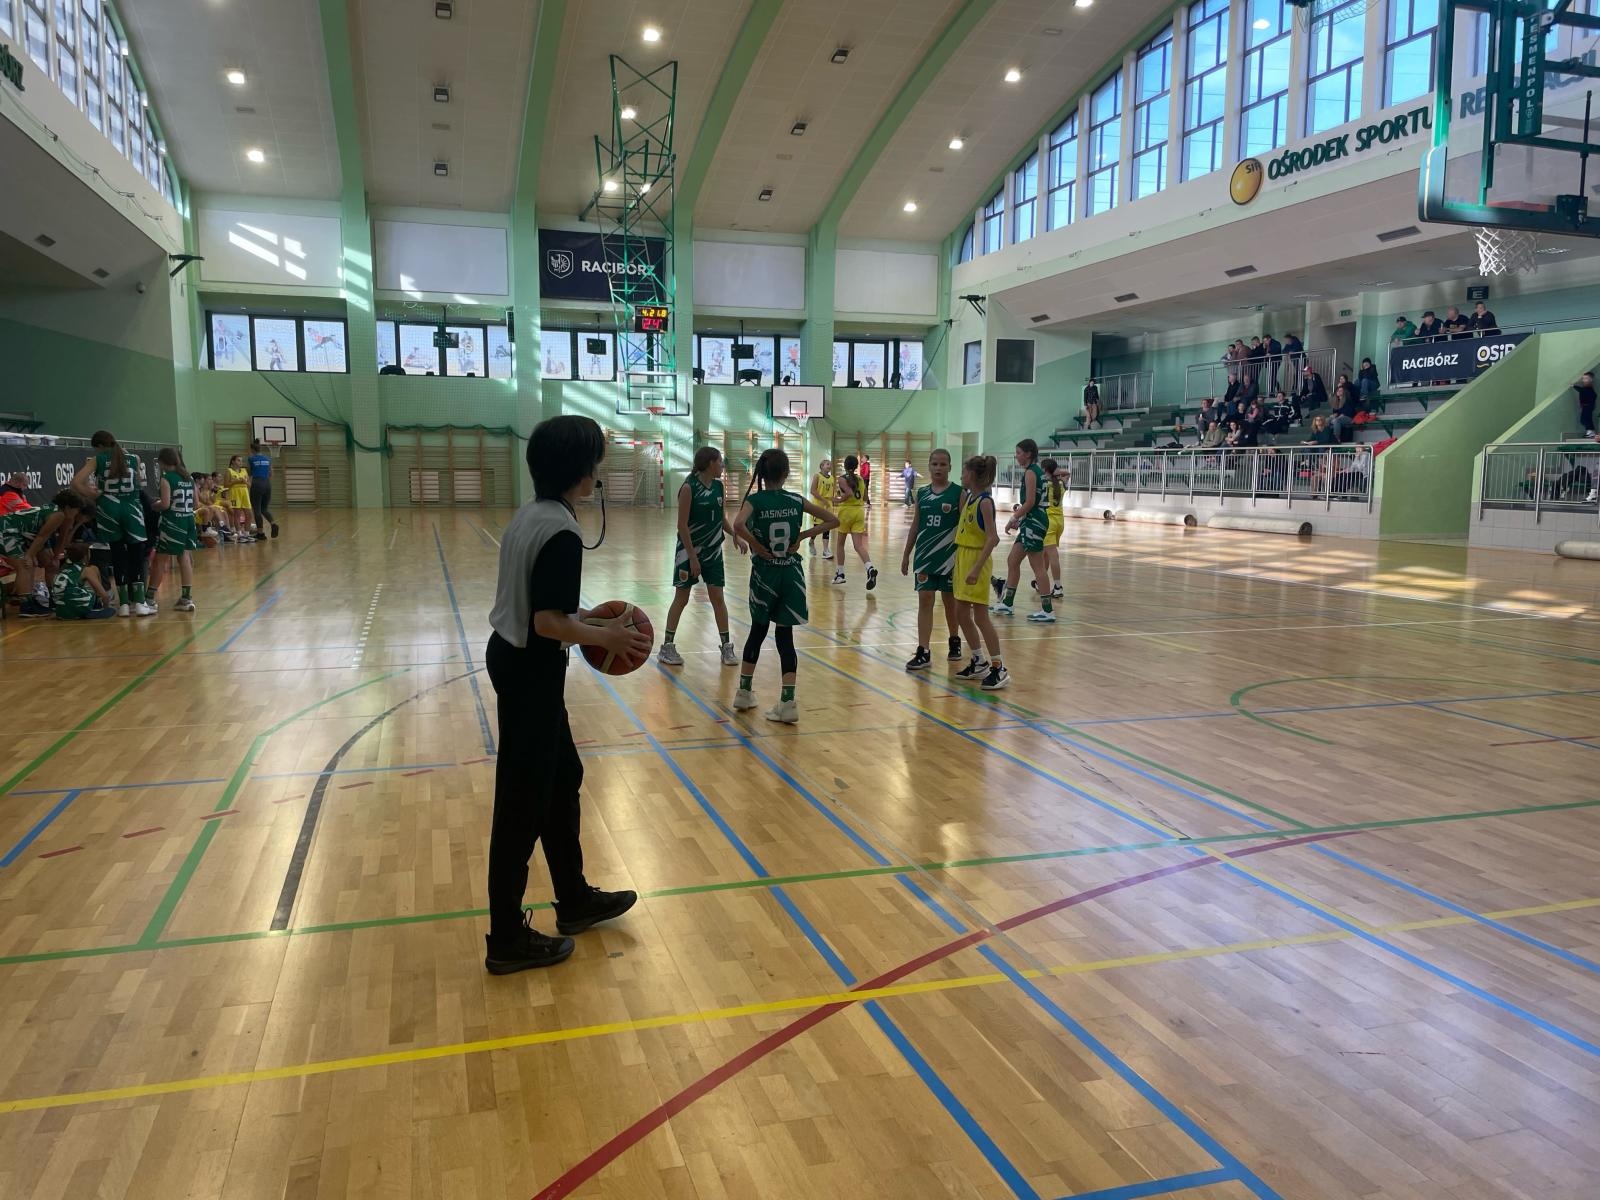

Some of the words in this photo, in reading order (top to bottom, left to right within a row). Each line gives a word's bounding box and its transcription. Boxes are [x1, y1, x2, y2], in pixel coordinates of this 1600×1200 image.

[1526, 17, 1538, 107] ESMENPOL
[1267, 133, 1350, 180] OŚRODEK
[1402, 352, 1459, 370] RACIBÓRZ
[170, 488, 194, 513] 22
[926, 514, 942, 527] 38
[769, 521, 790, 558] 8
